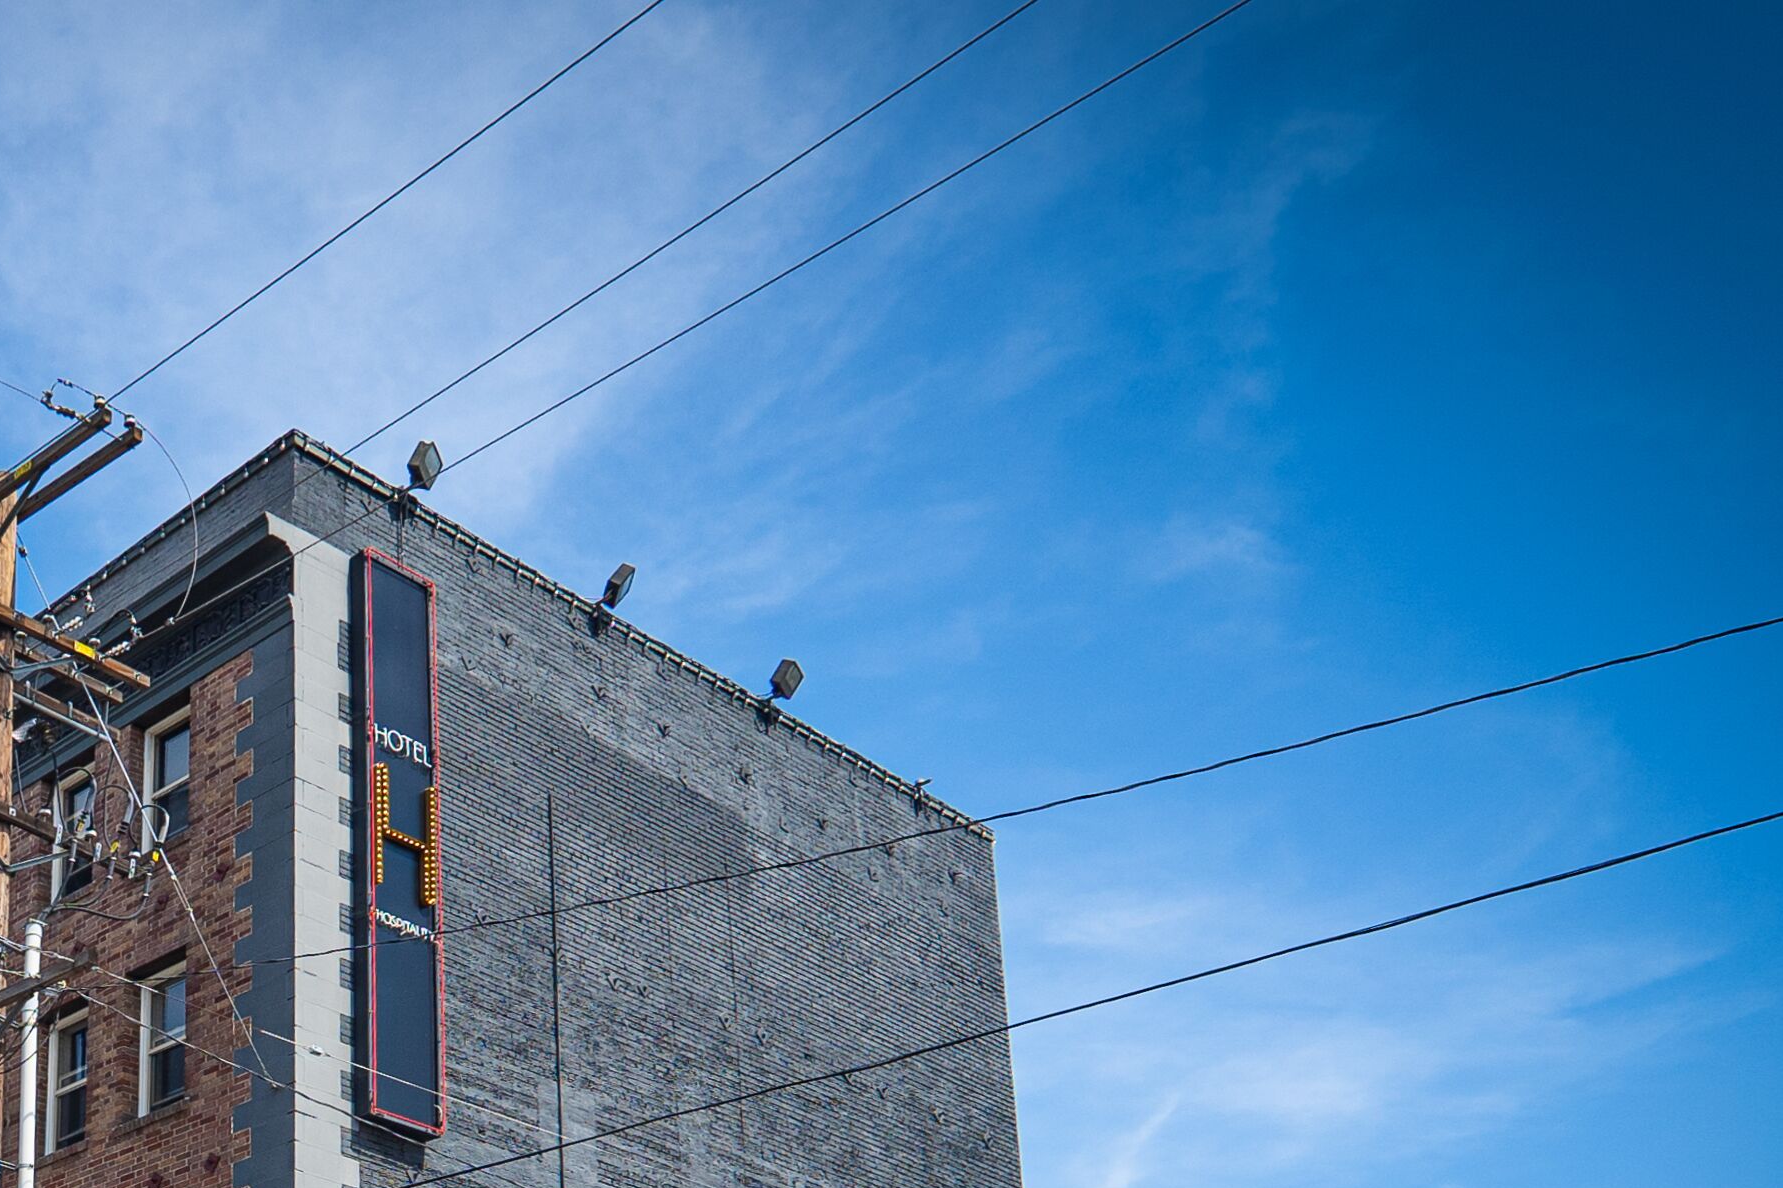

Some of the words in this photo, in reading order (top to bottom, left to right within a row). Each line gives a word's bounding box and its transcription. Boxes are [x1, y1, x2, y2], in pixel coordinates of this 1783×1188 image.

[374, 723, 432, 768] HOTEL
[374, 762, 437, 906] H
[376, 908, 436, 942] HOSPITALITY
